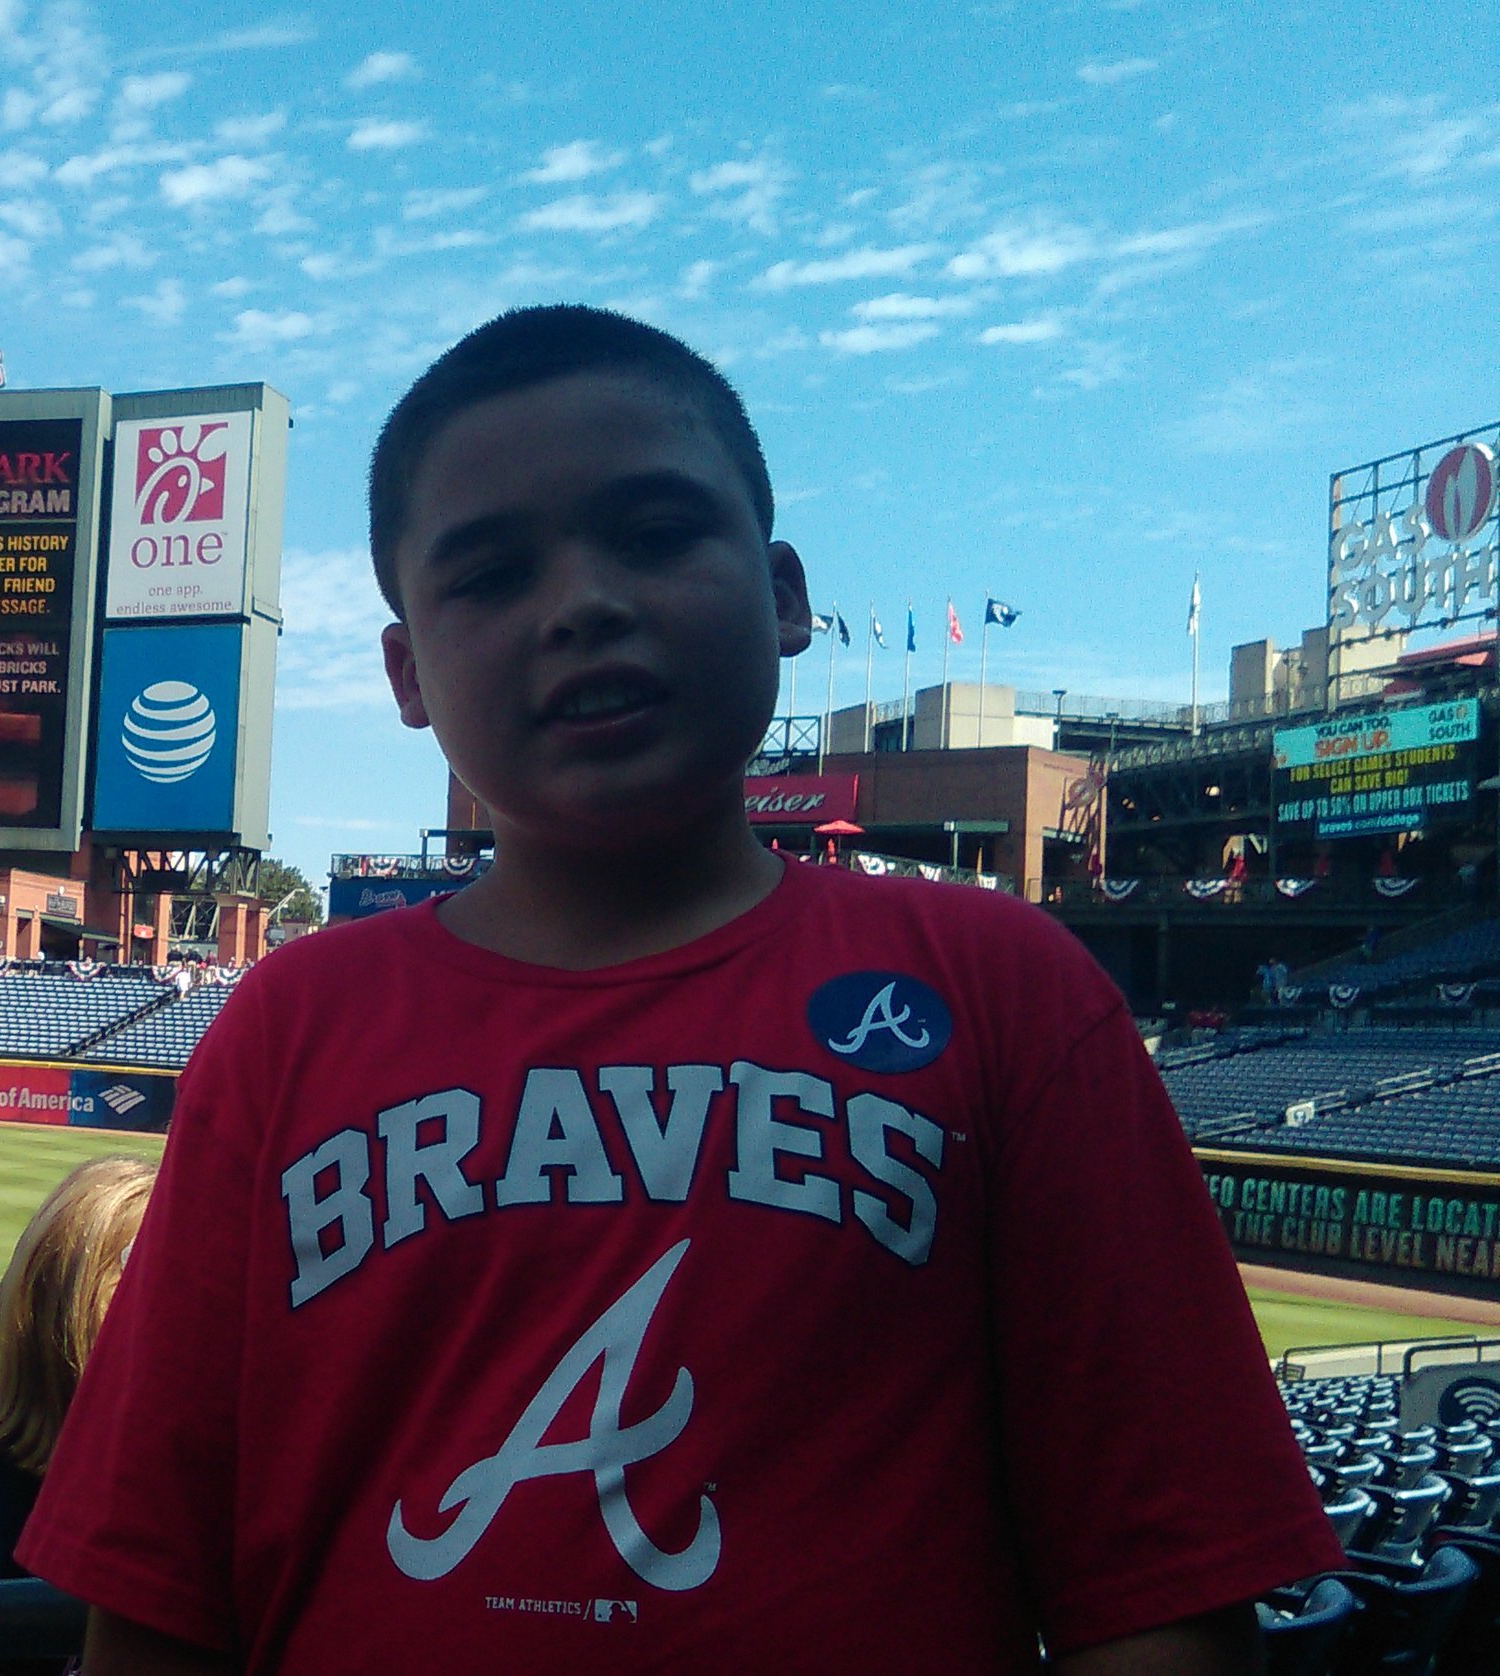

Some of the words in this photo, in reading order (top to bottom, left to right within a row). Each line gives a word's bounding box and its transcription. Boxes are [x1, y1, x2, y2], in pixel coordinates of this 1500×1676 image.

[7, 535, 68, 551] HISTORY
[1334, 505, 1430, 571] GAS
[131, 532, 224, 569] one
[19, 556, 47, 572] FOR
[4, 577, 56, 593] FRIEND
[149, 587, 172, 597] one
[176, 584, 203, 598] app.
[1331, 545, 1499, 630] SOUTH
[116, 601, 166, 615] endless
[170, 599, 235, 614] awesome.
[27, 643, 59, 655] WILL
[21, 680, 61, 693] PARK.
[1428, 706, 1455, 724] GAS
[1428, 721, 1471, 740] SOUTH
[17, 1087, 94, 1112] America
[279, 1058, 948, 1311] BRAVES
[1241, 1177, 1347, 1221] CENTERS
[1353, 1189, 1403, 1229] ARE
[1412, 1195, 1500, 1240] LOCAT
[386, 1236, 722, 1593] A
[485, 1597, 515, 1610] TEAM
[519, 1599, 581, 1615] ATHLETICS
